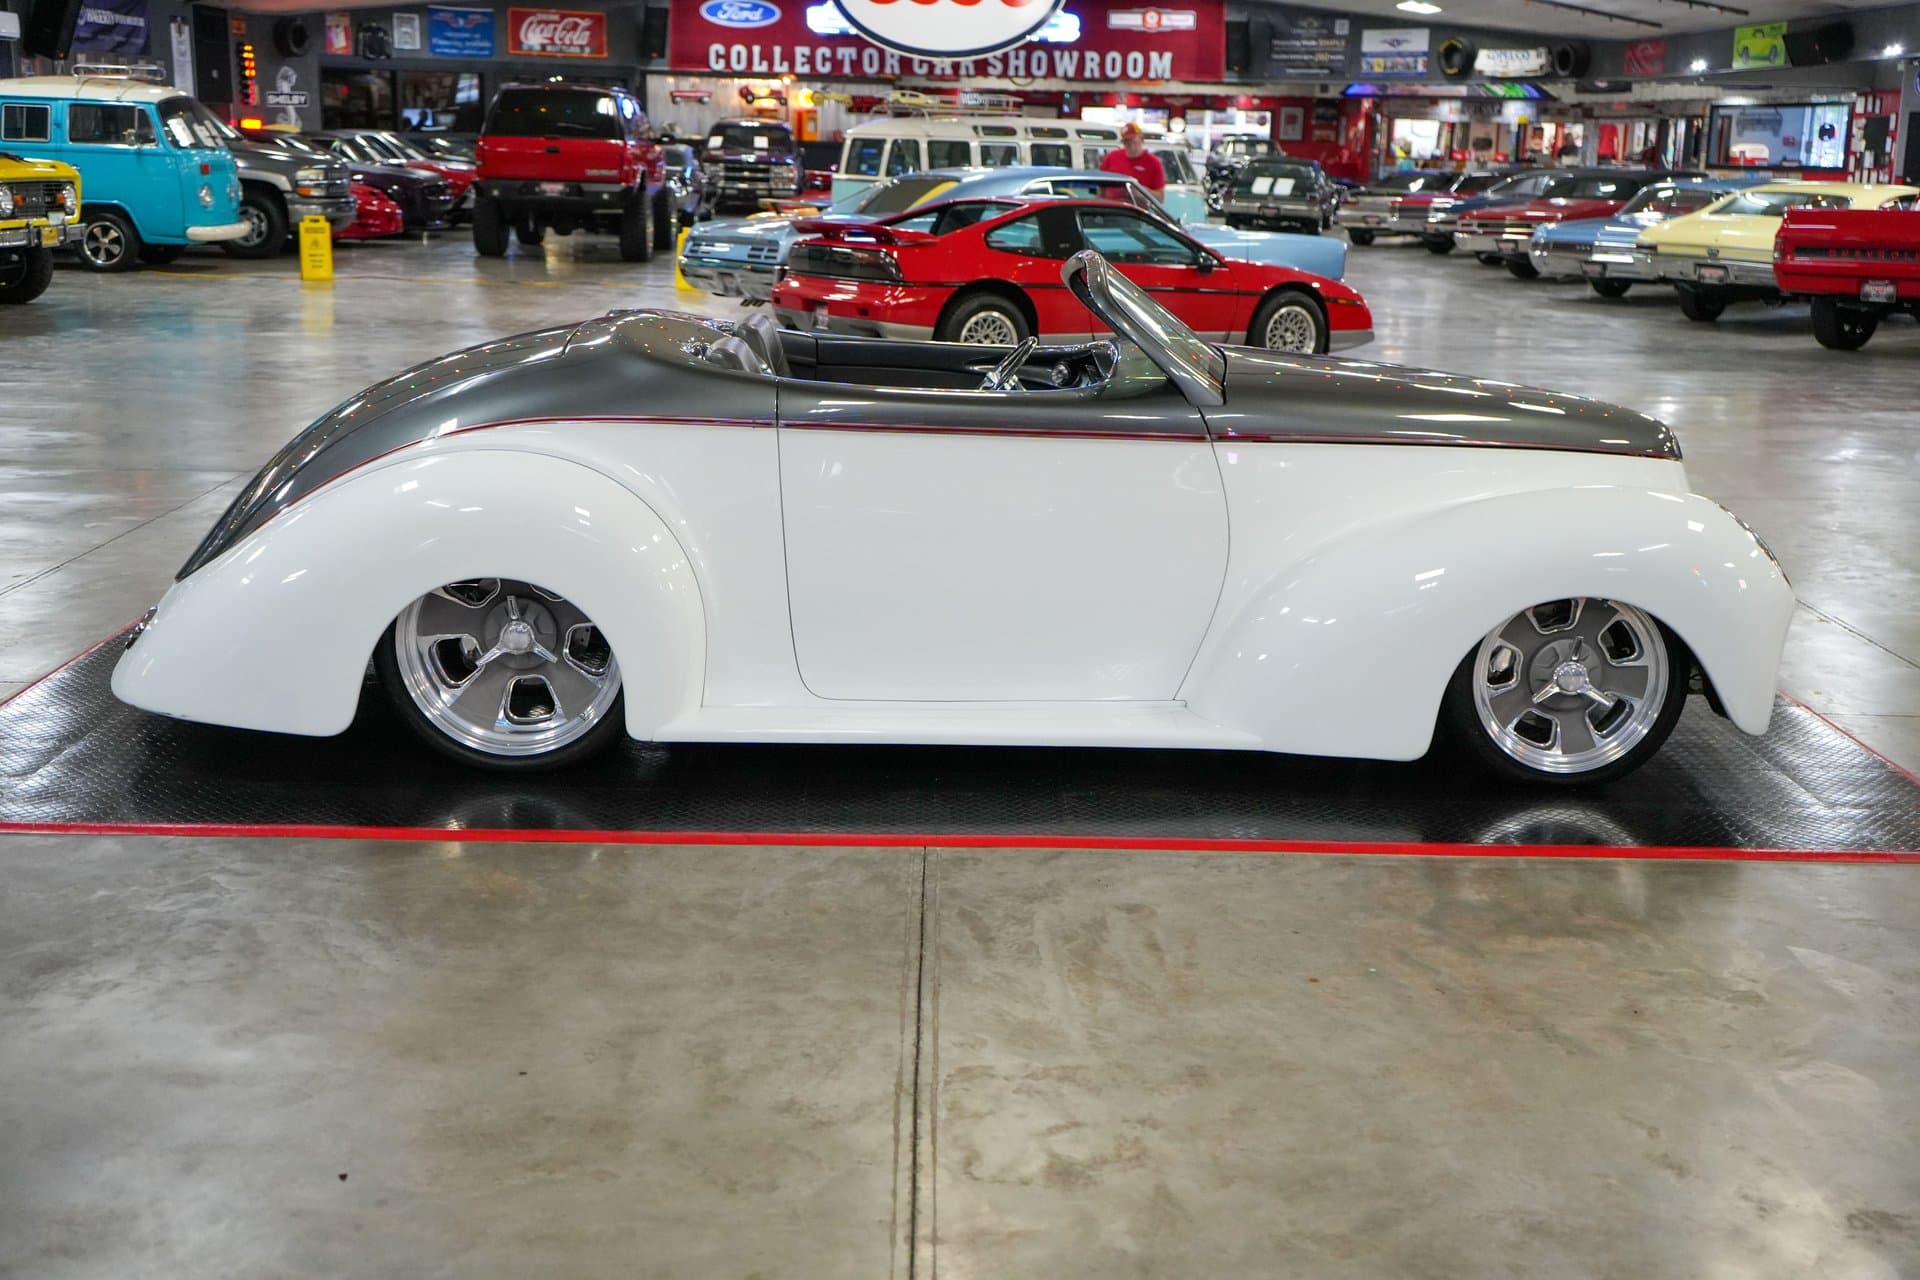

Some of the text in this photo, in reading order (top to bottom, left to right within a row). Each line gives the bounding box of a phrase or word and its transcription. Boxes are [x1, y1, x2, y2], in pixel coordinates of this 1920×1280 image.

[717, 2, 763, 22] Ford
[519, 15, 593, 46] Coca-Cola
[708, 43, 1174, 79] COLLECTOR CAR SHOWROOM
